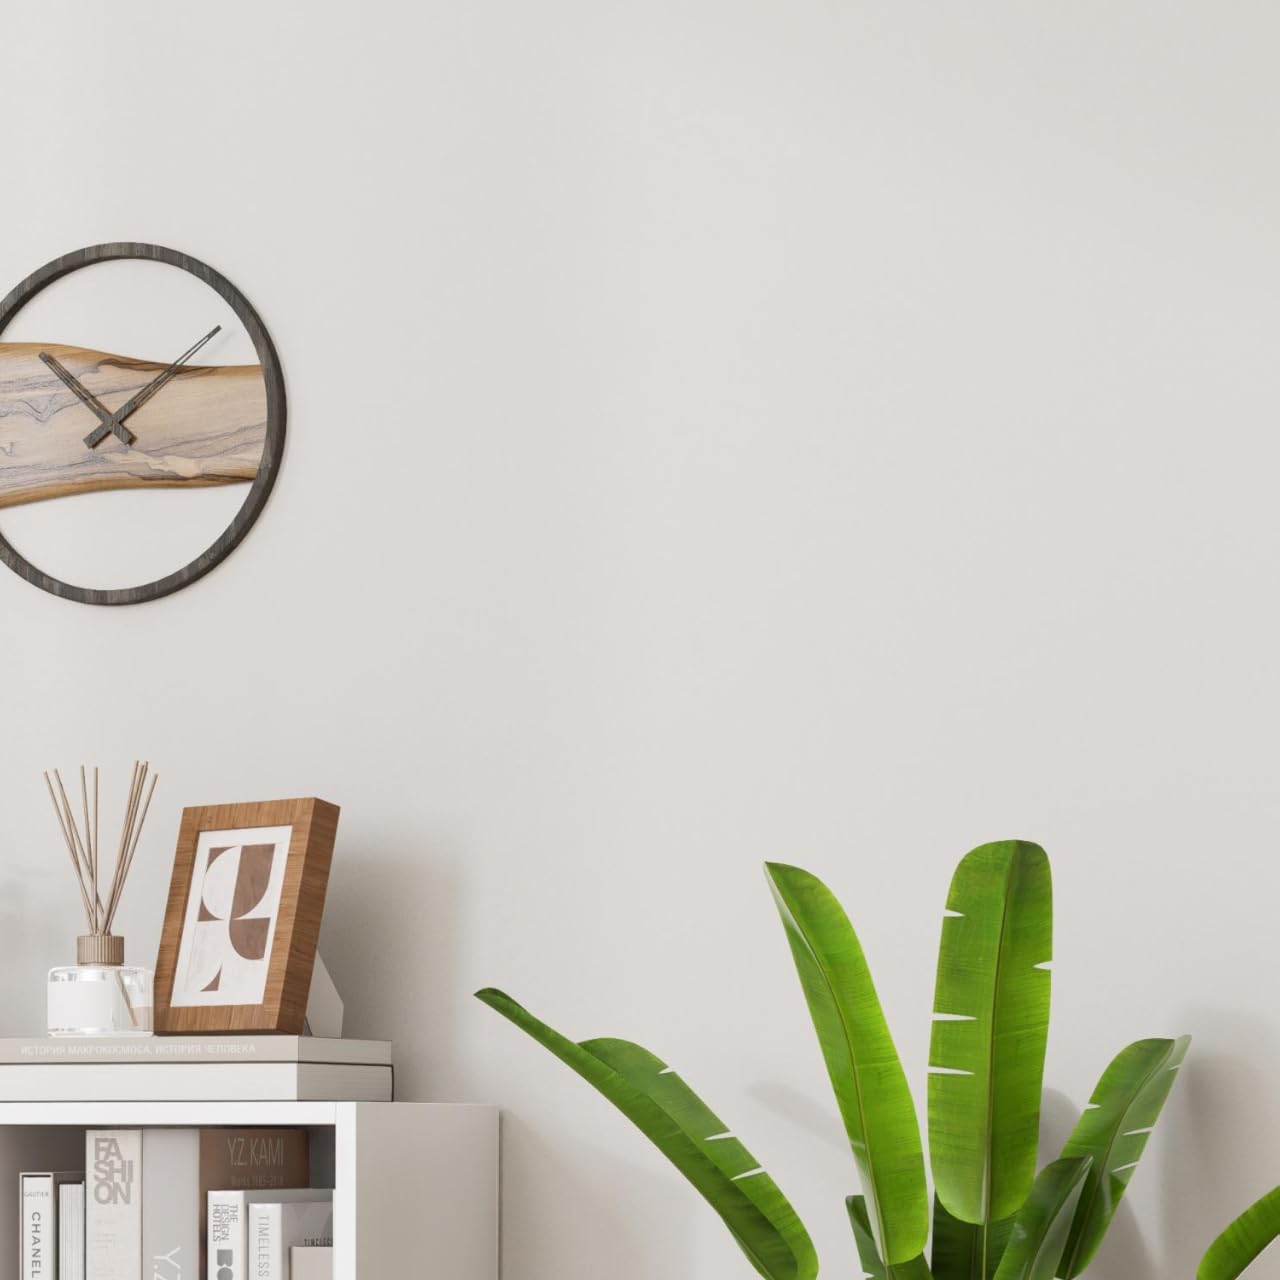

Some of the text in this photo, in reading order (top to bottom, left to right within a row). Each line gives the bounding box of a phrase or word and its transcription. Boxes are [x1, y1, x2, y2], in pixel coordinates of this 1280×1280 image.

[250, 1136, 284, 1168] KAMI
[94, 1182, 131, 1205] ON
[212, 1204, 221, 1242] HOTELS
[221, 1204, 230, 1241] DESIGN
[229, 1204, 238, 1223] THE
[31, 1211, 41, 1278] CHANEL
[258, 1216, 270, 1277] TIMELESS
